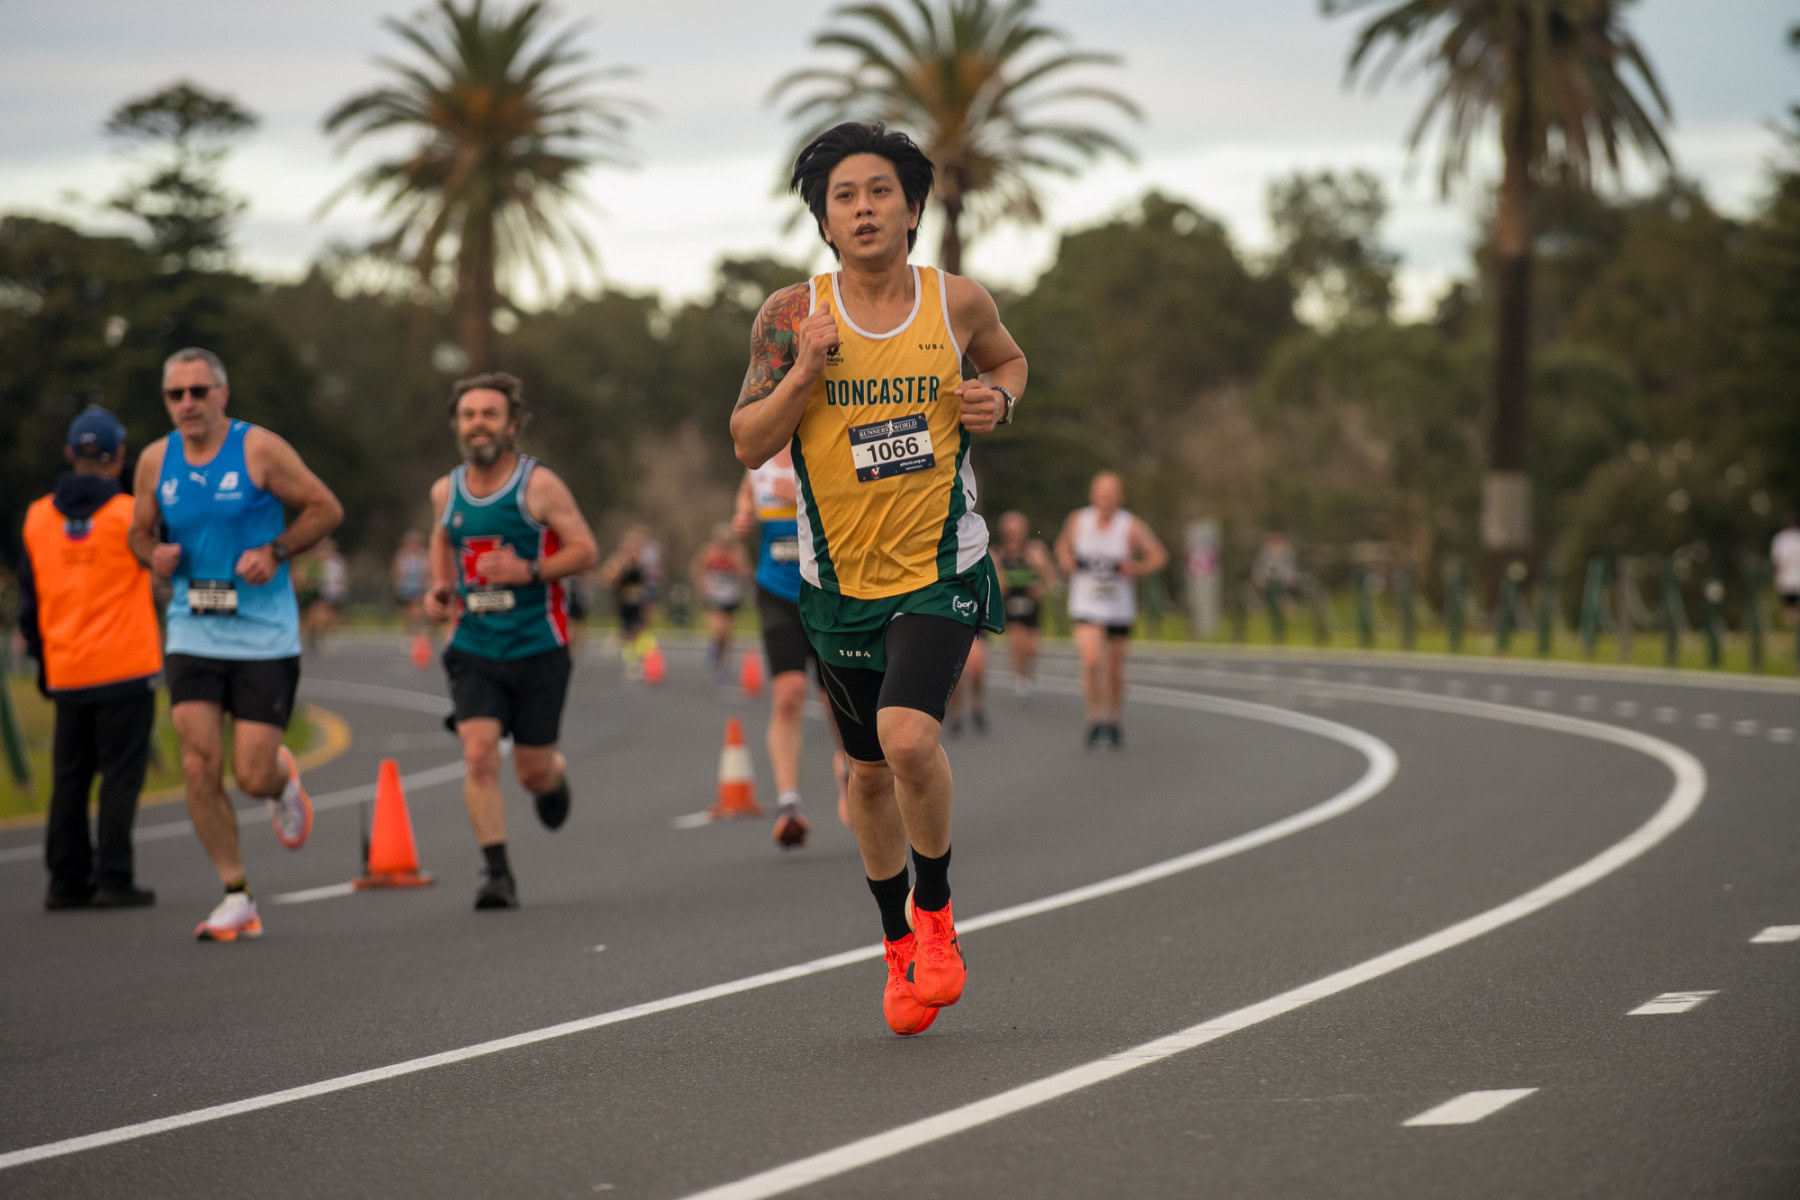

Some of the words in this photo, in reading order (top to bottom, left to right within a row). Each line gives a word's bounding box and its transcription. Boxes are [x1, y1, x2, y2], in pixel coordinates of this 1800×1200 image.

[825, 375, 940, 406] DONCASTER
[894, 420, 917, 431] WORLD
[867, 436, 919, 462] 1066
